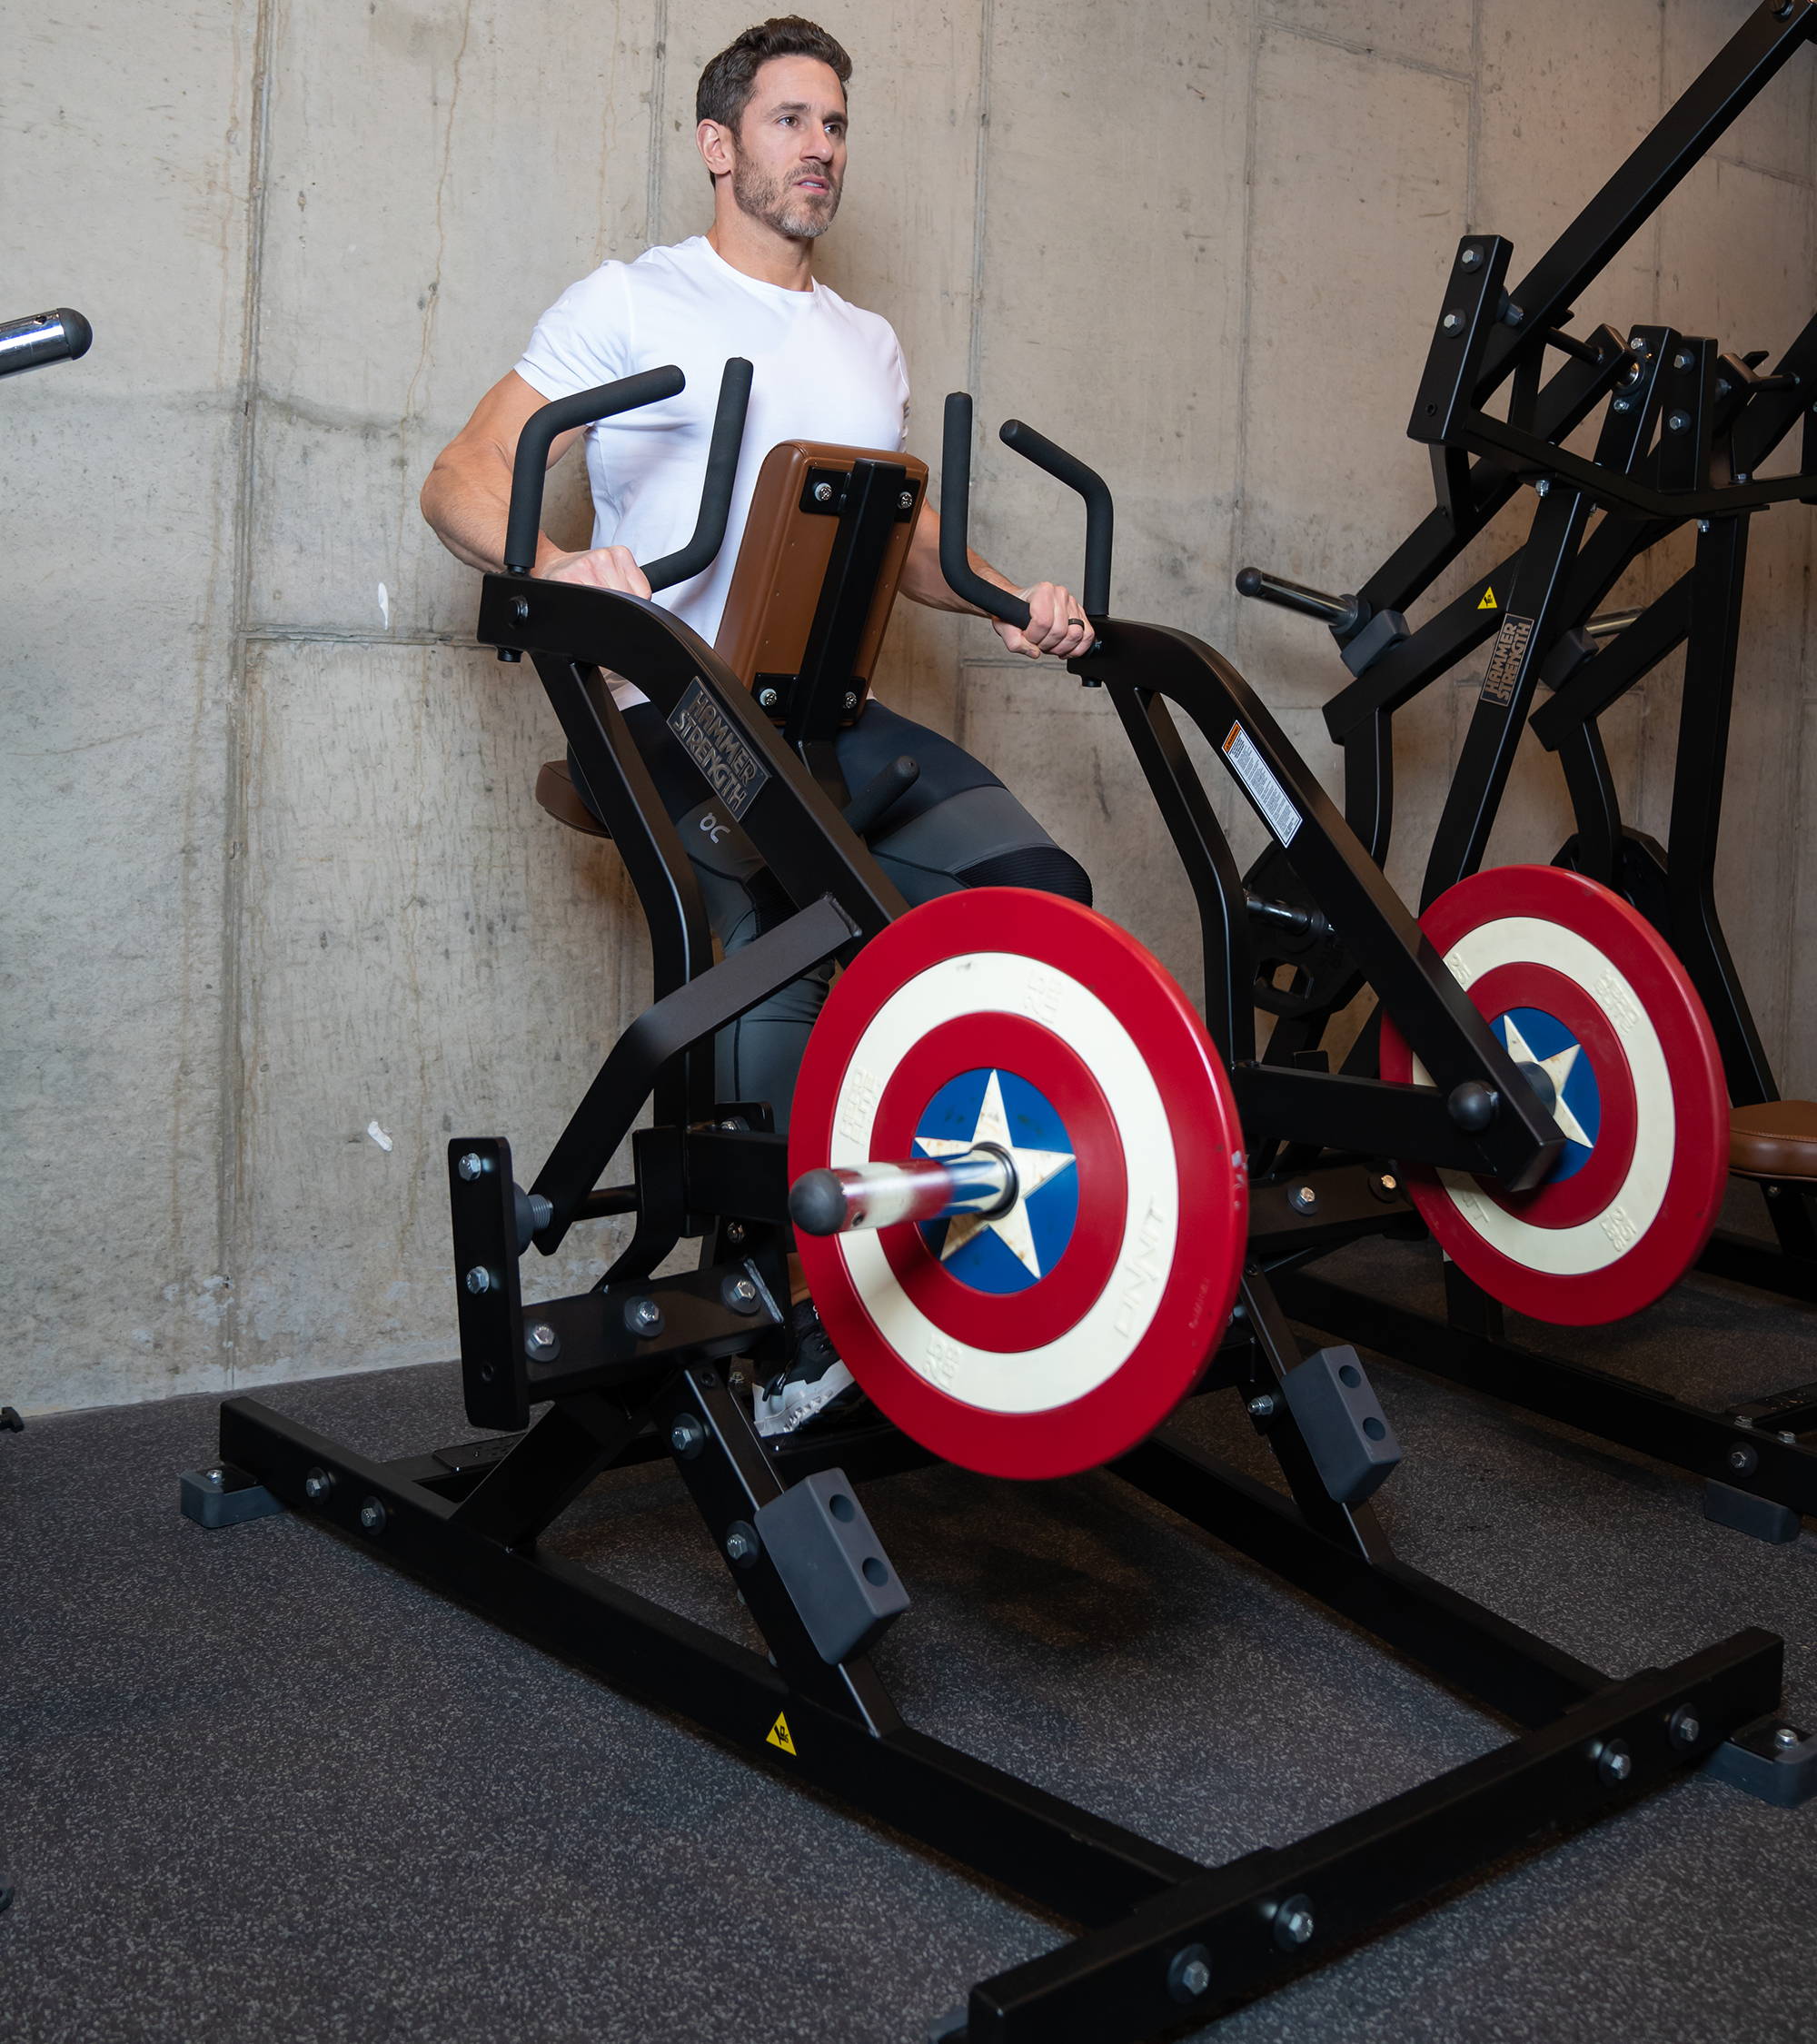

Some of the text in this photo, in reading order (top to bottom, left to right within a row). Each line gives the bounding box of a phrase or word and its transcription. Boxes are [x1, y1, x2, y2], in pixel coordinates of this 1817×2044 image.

[1484, 621, 1518, 695] HAMMER
[1496, 621, 1531, 701] STRENGTH
[675, 709, 748, 812] STRENGTH
[687, 690, 758, 786] HAMMER
[1608, 1206, 1637, 1242] 25
